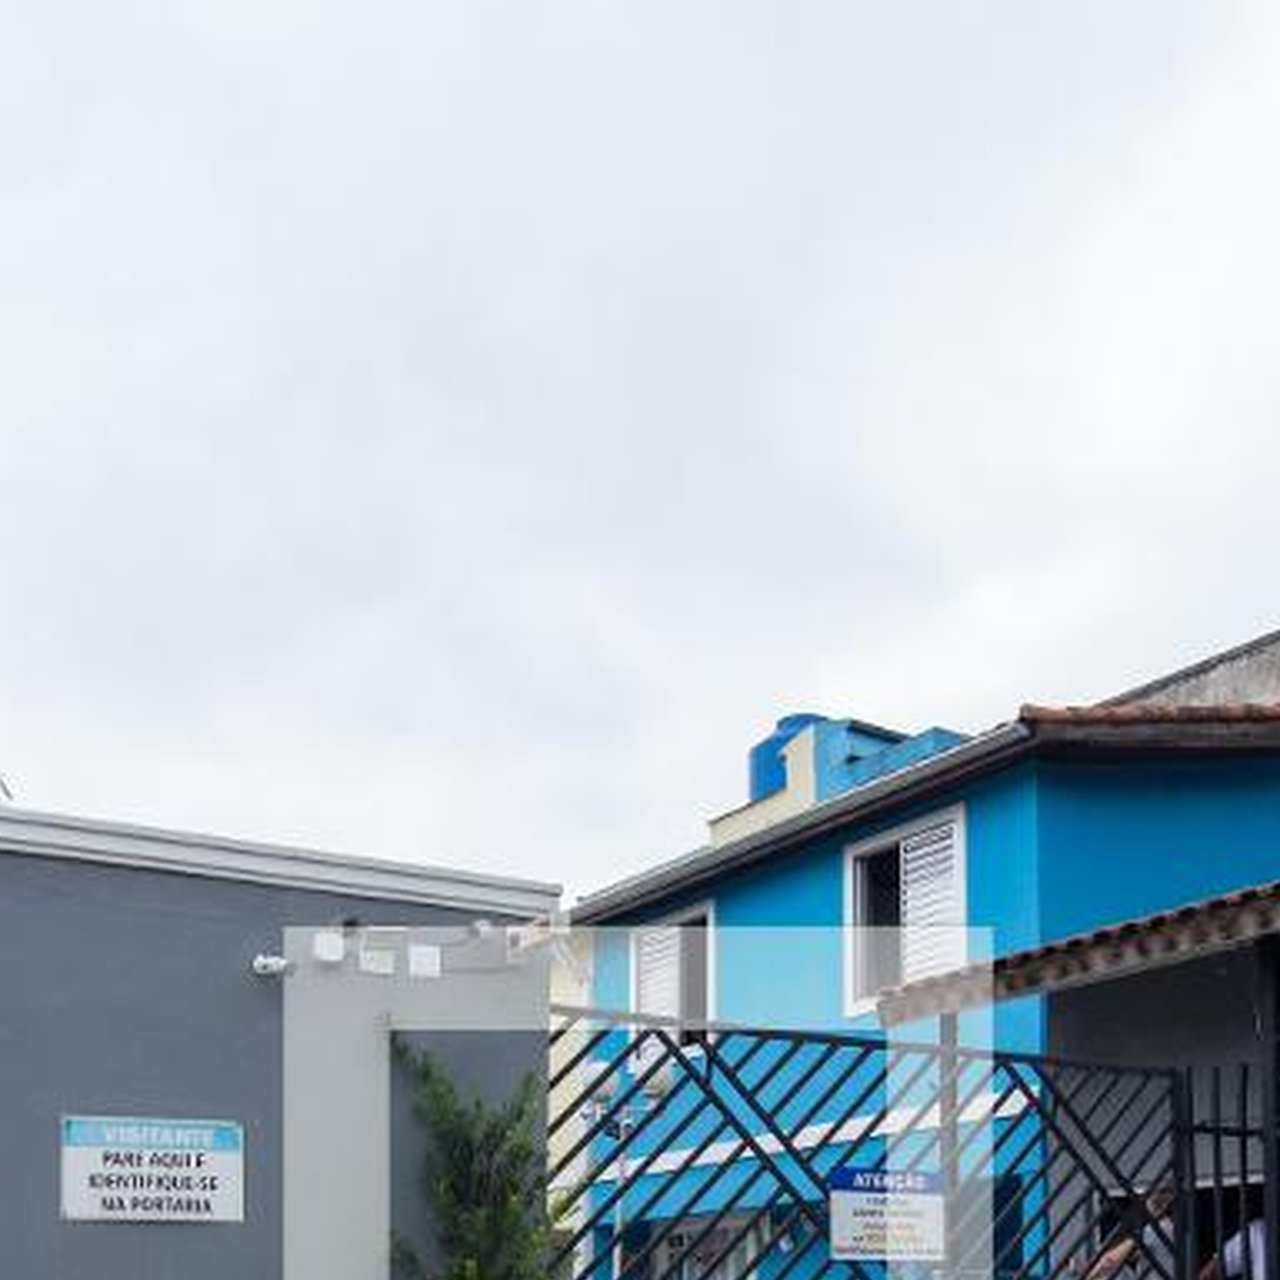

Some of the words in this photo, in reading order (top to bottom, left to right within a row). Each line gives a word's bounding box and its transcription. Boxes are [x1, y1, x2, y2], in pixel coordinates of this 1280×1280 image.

[105, 1125, 213, 1148] VISITANTE
[102, 1152, 144, 1168] PARE
[149, 1152, 193, 1168] AQUI
[88, 1173, 219, 1192] IDENTIFIQUE-SE
[101, 1197, 127, 1211] NA
[131, 1197, 213, 1213] PORTARIA
